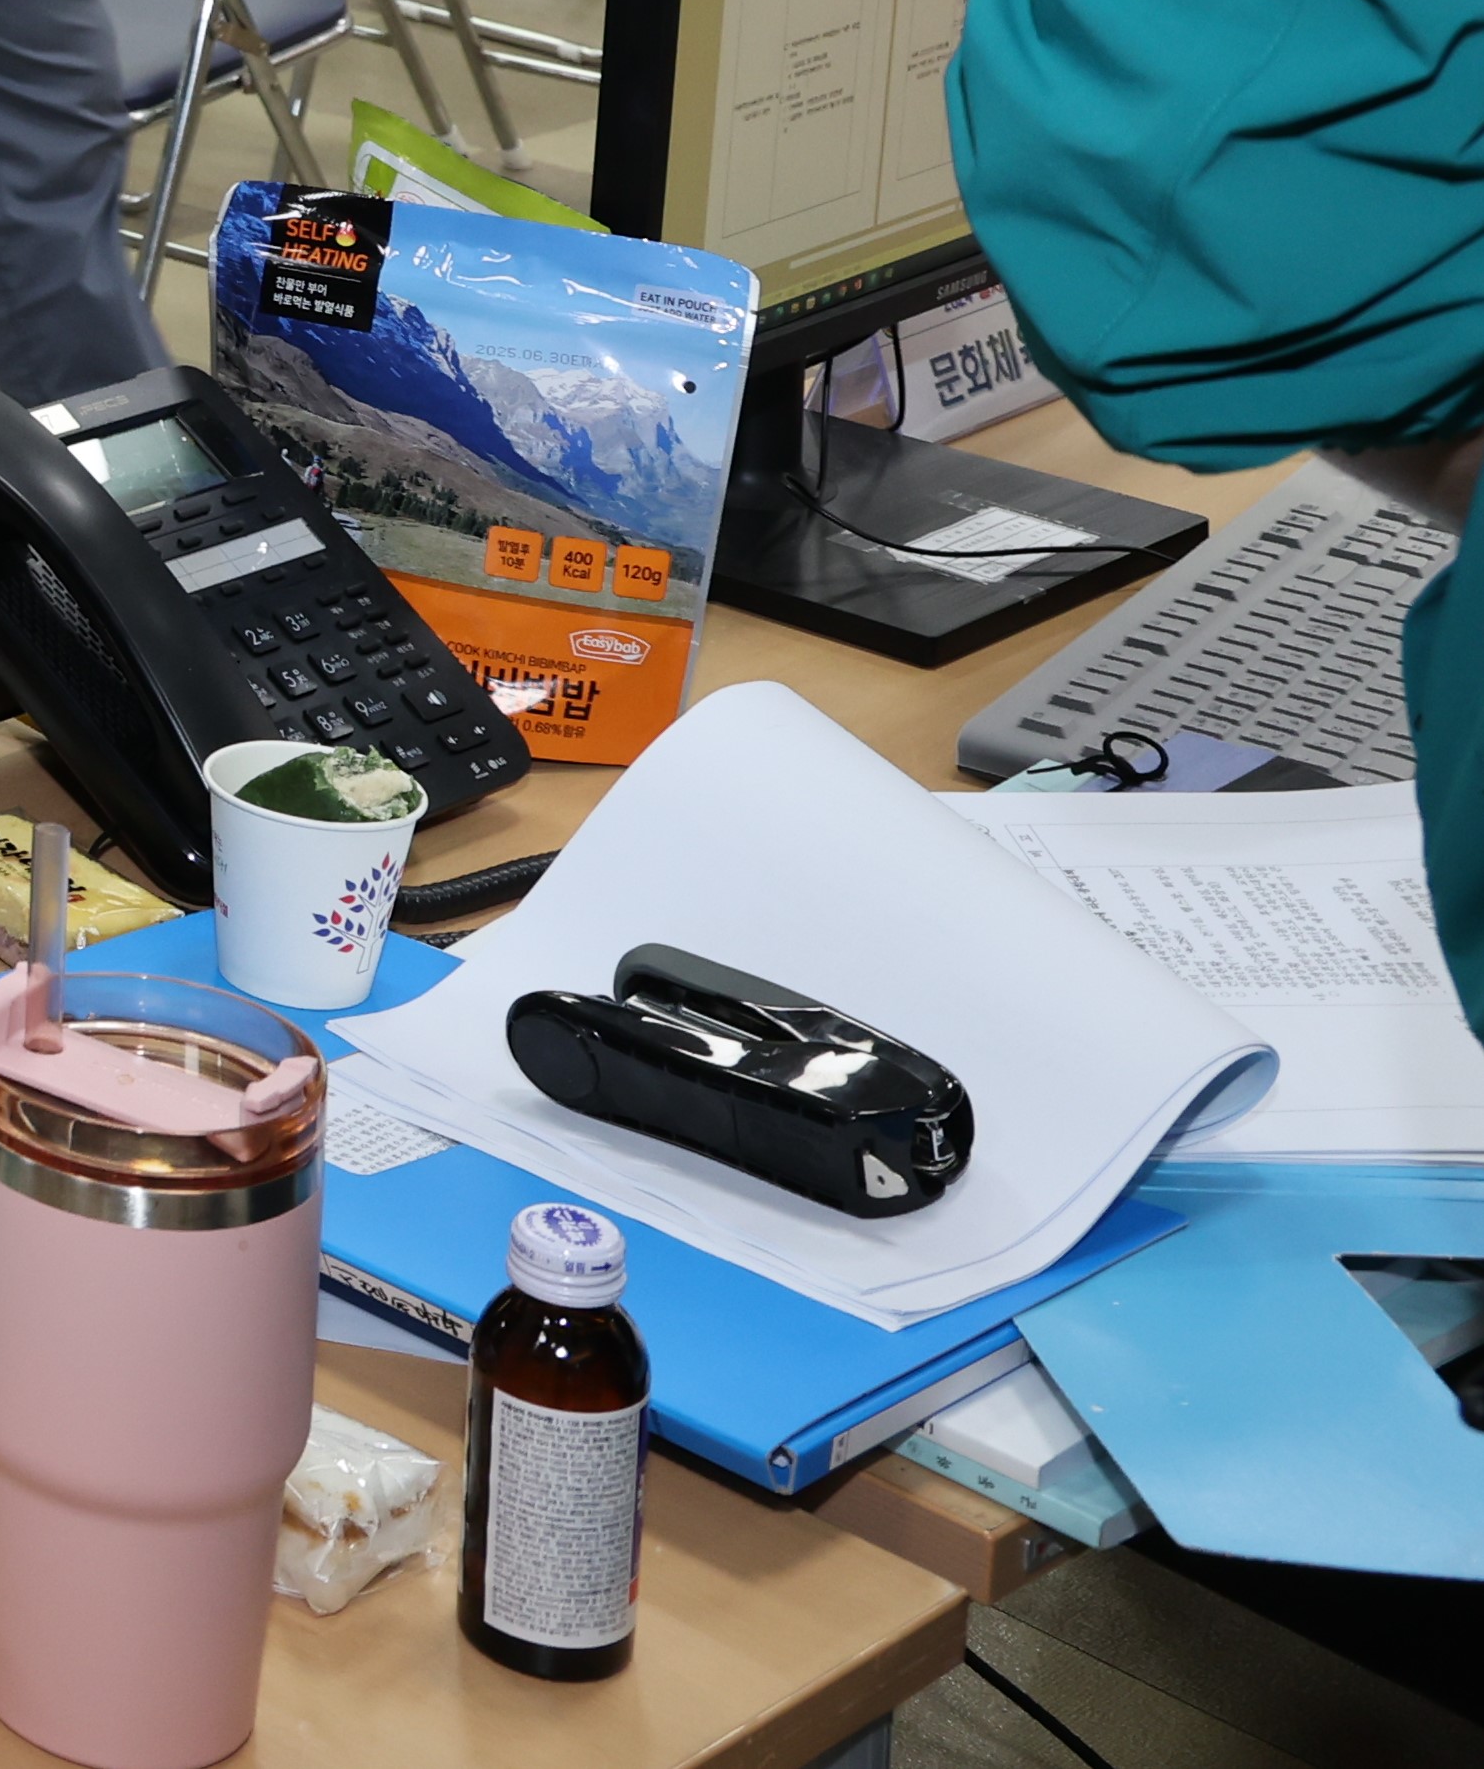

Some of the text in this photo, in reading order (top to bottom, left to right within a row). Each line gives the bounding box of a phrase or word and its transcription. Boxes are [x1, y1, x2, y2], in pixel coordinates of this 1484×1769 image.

[286, 219, 335, 242] SELF
[281, 242, 368, 272] HEATING
[276, 276, 328, 296] 찬물만 부어
[273, 292, 355, 318] 바로먹는 발열식품
[640, 292, 662, 304] EAT
[678, 298, 718, 313] POUCH
[498, 539, 530, 555] 발열후
[501, 555, 525, 570] 10분
[565, 551, 593, 566] 400
[563, 566, 591, 580] Kcal
[622, 564, 662, 585] 120g
[584, 635, 640, 655] Easybab
[446, 640, 587, 675] COOK KIMCHI BIBIMBAP
